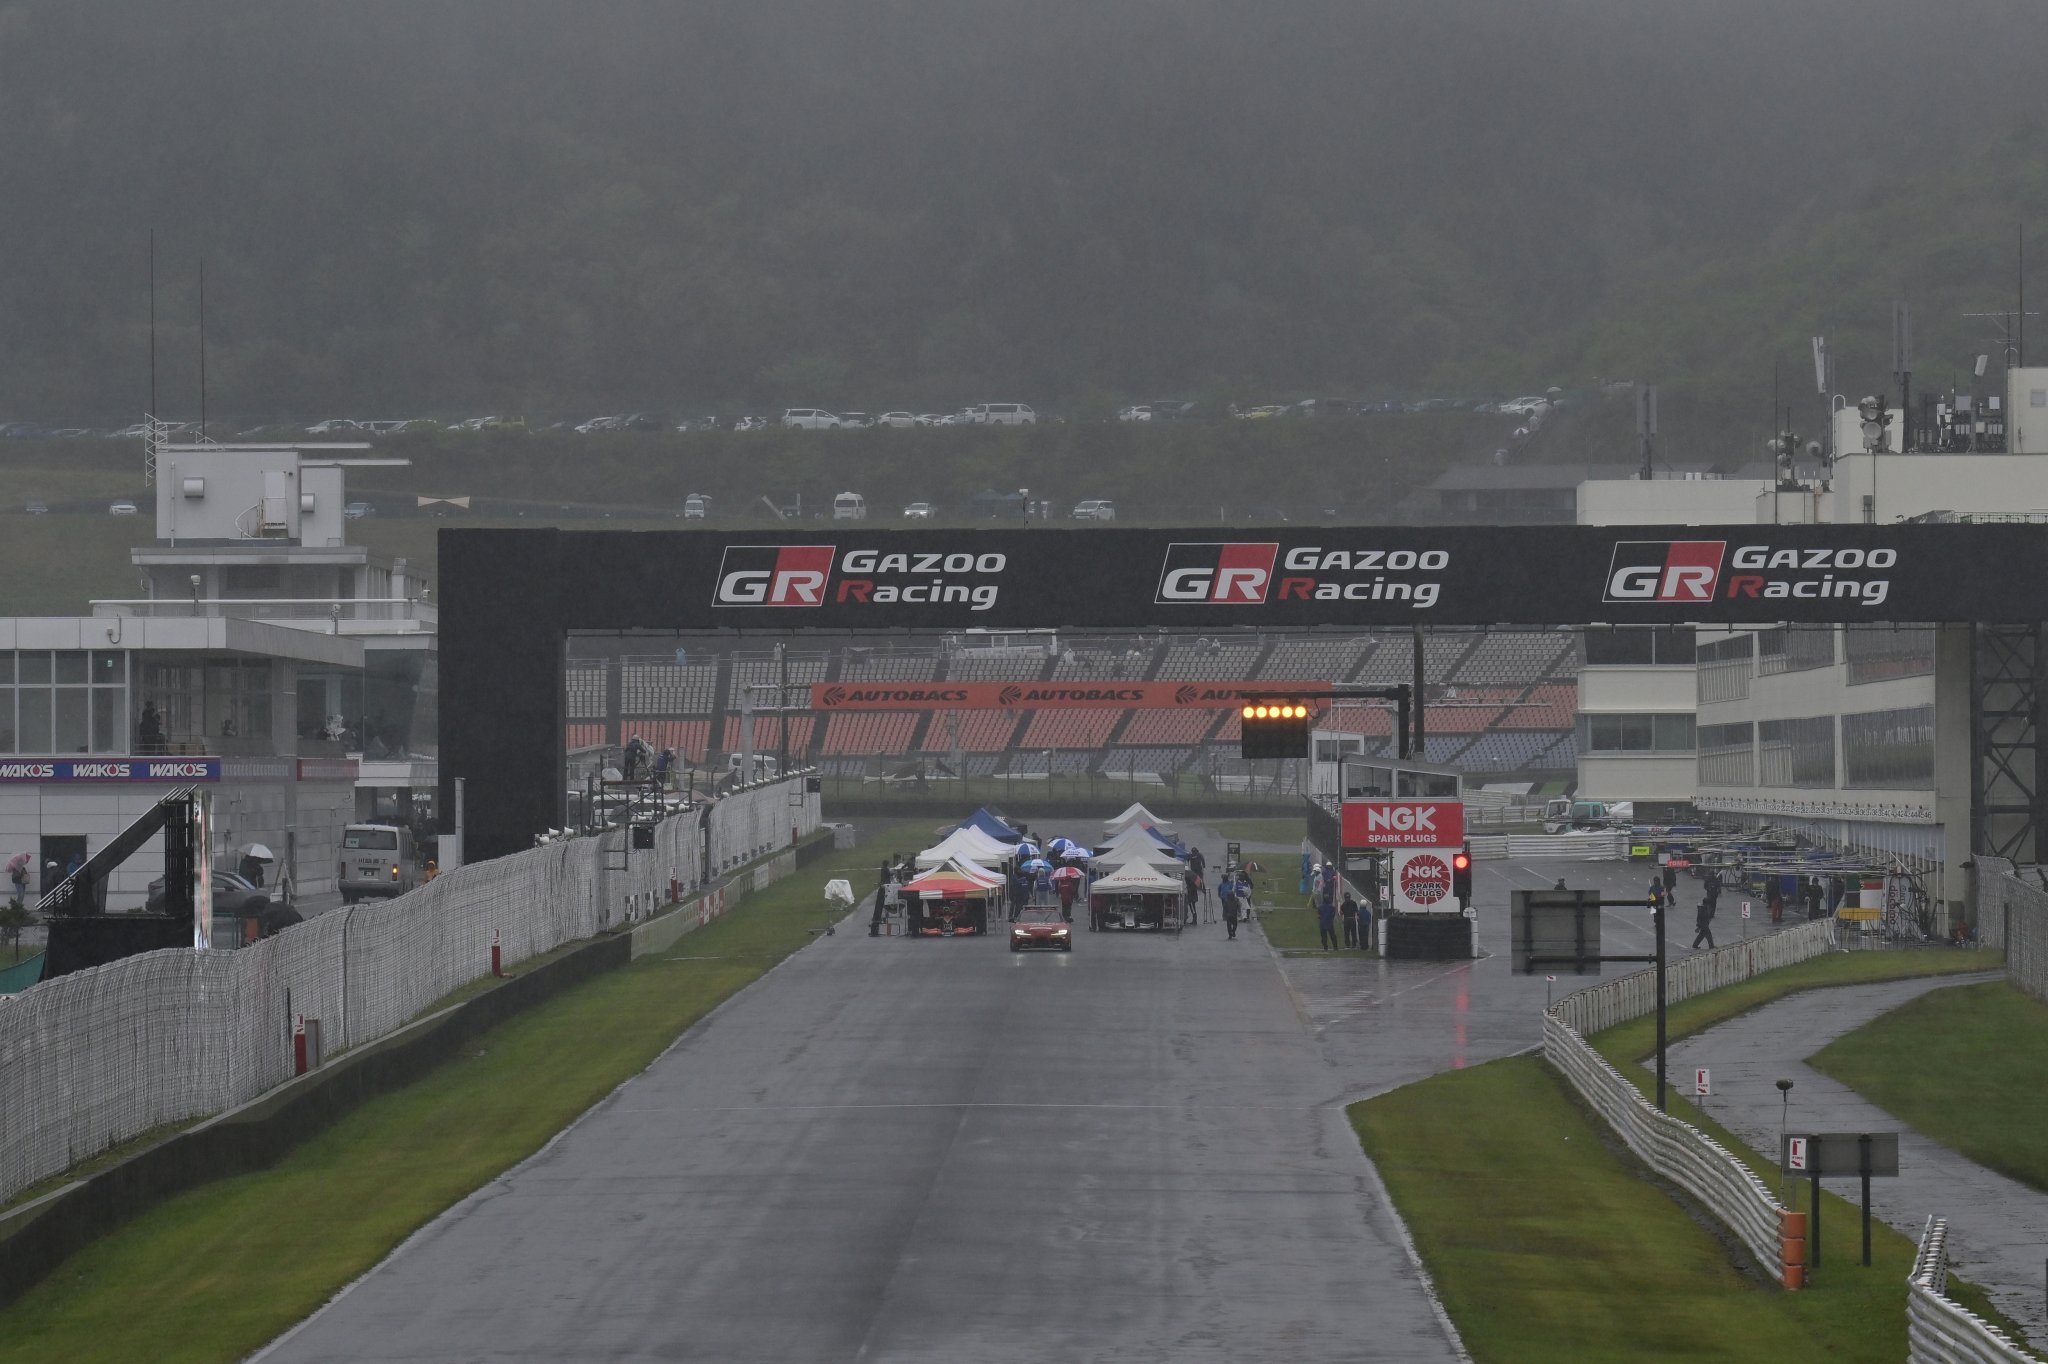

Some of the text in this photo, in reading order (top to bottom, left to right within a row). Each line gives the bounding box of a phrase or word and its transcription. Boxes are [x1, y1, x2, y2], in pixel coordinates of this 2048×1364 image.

[841, 550, 1007, 573] GAZOO
[1284, 547, 1450, 570] GAZOO
[1732, 545, 1898, 569] GAZOO
[719, 570, 824, 602] GR
[1162, 567, 1267, 600] GR
[1278, 576, 1441, 608] Racing
[1609, 566, 1715, 598] GR
[1727, 574, 1890, 606] Racing
[836, 579, 999, 611] Racing
[847, 689, 969, 701] AUTOBACS
[1022, 689, 1145, 701] AUTOBACS
[1368, 806, 1437, 831] NGK
[1368, 834, 1437, 843] SPARK PLUGS
[1408, 866, 1442, 878] NGK
